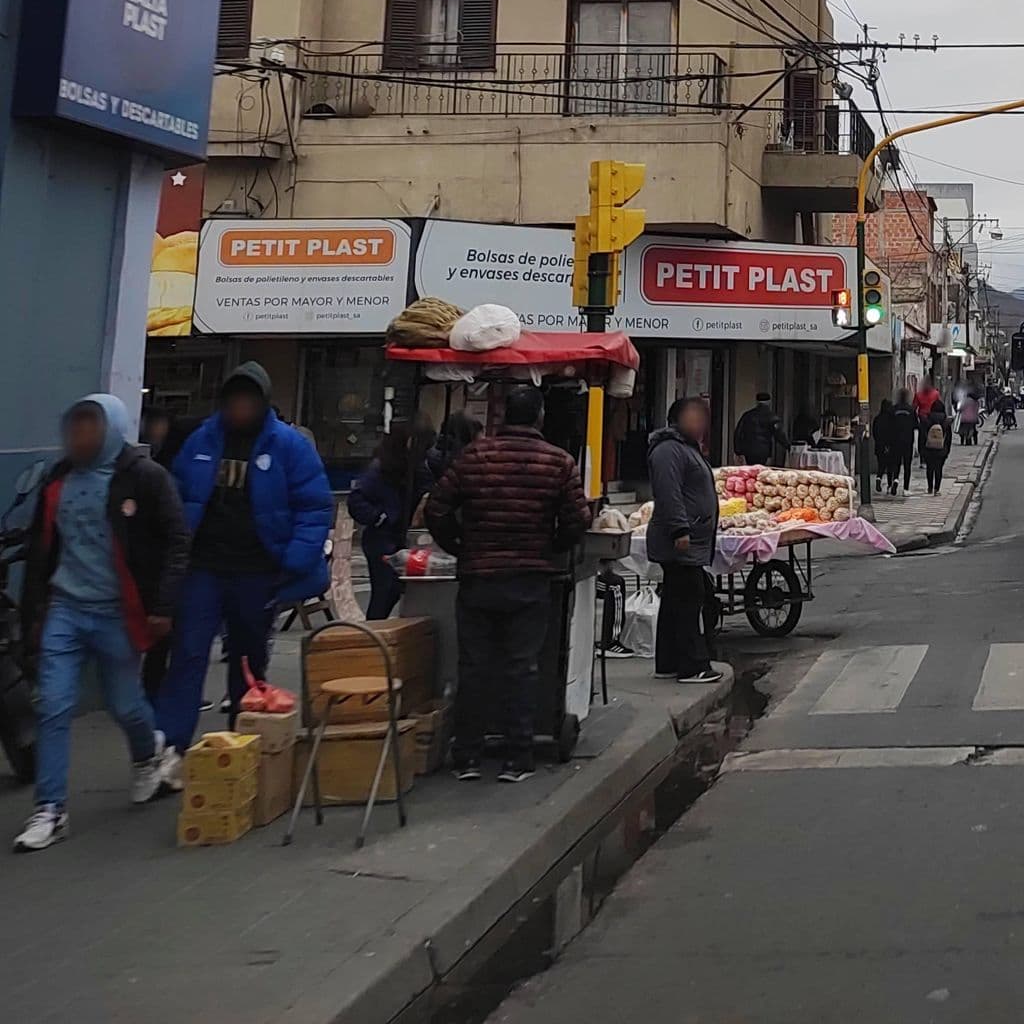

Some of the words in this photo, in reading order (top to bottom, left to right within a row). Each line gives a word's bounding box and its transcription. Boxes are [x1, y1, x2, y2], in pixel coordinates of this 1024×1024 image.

[123, 2, 168, 40] PLAST
[59, 78, 108, 111] BOLSAS
[110, 95, 121, 114] Y
[121, 100, 199, 140] DESCARTABLES
[231, 239, 301, 257] PETIT
[307, 238, 384, 256] PLAST
[466, 249, 515, 264] Bolsas
[518, 251, 537, 265] de
[539, 253, 575, 268] polie
[215, 276, 243, 284] Bolsas
[255, 276, 299, 284] polietileno
[341, 275, 394, 283] descartables
[446, 266, 457, 281] y
[459, 268, 518, 281] envases
[522, 269, 574, 284] descar
[656, 262, 740, 290] PETIT
[748, 266, 833, 293] PLAST
[216, 297, 261, 307] VENTAS
[264, 297, 289, 307] POR
[291, 296, 333, 306] MAYOR
[335, 296, 343, 306] Y
[346, 296, 390, 306] MENOR
[255, 313, 289, 321] petitplast
[537, 315, 564, 327] POR
[568, 315, 612, 328] MAR
[615, 317, 622, 328] Y
[625, 318, 669, 329] MENOR
[705, 320, 742, 331] petitplast
[772, 320, 818, 332] petitplast_sa
